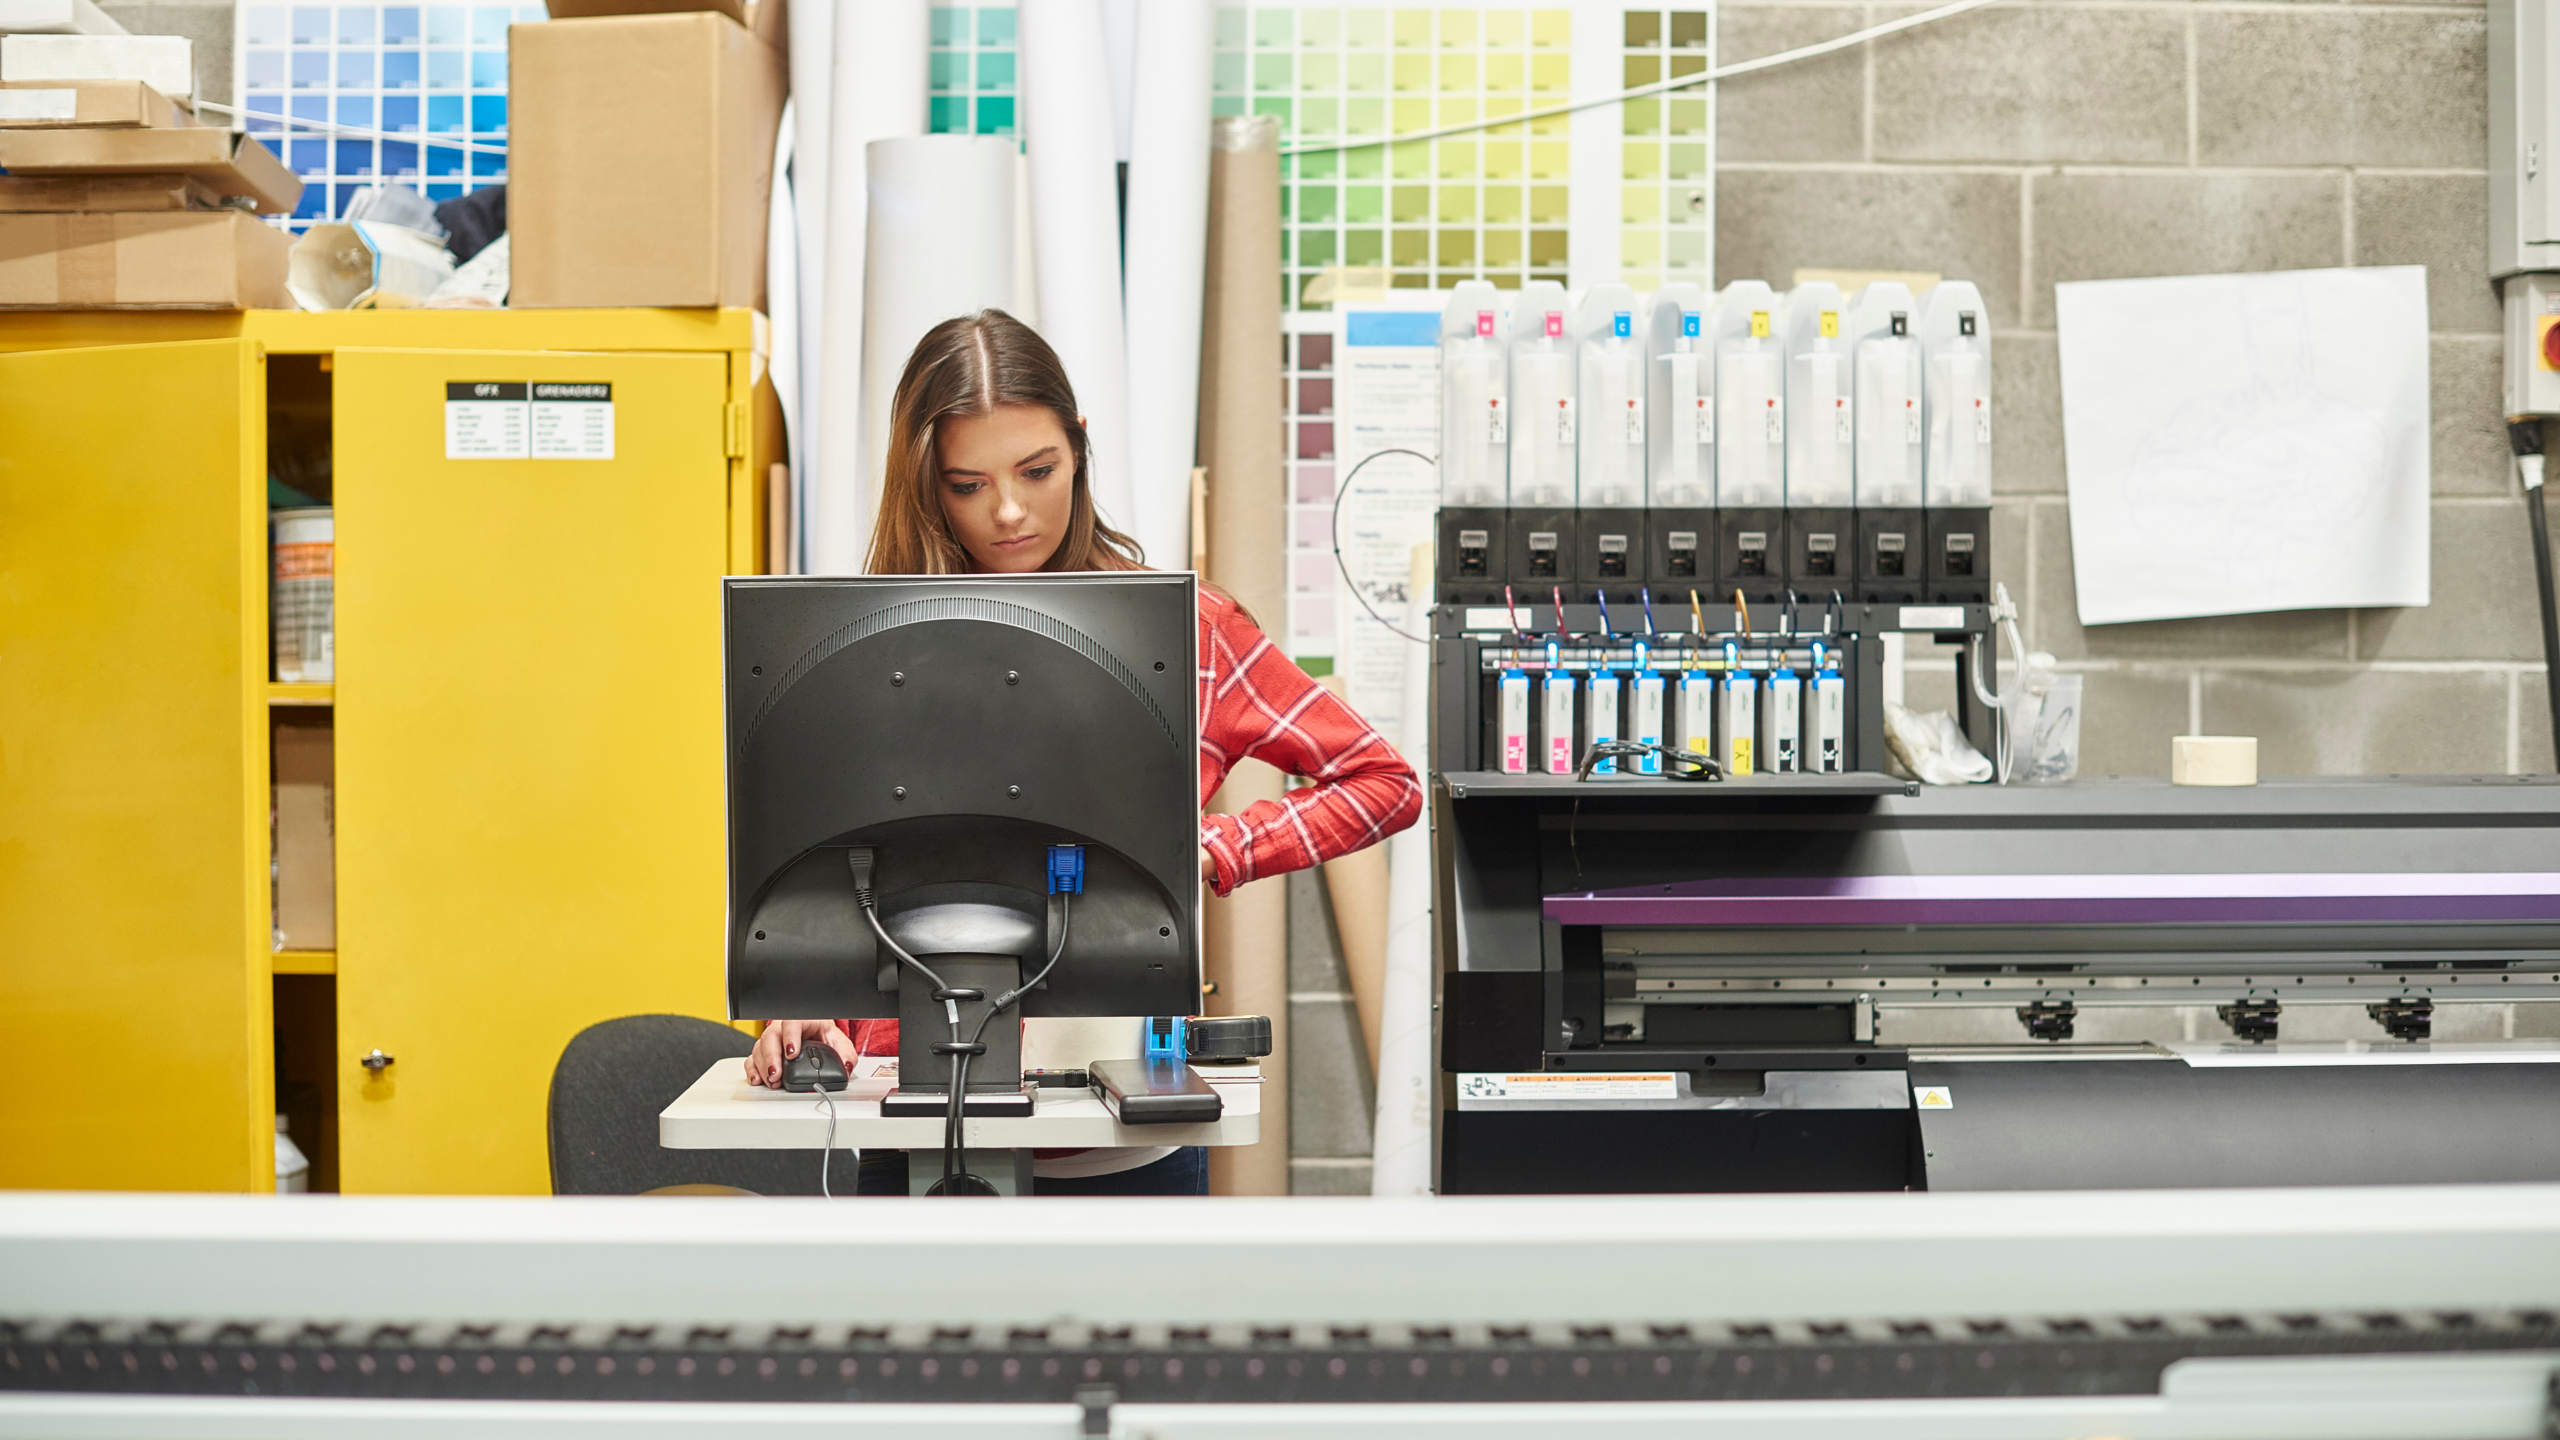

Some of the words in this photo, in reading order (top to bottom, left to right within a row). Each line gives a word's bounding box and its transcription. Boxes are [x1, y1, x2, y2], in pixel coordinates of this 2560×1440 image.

[474, 384, 500, 397] GFX
[1508, 746, 1520, 759] M
[1554, 748, 1566, 761] M
[1735, 751, 1745, 760] Y
[1780, 749, 1791, 760] K
[1824, 749, 1835, 760] K
